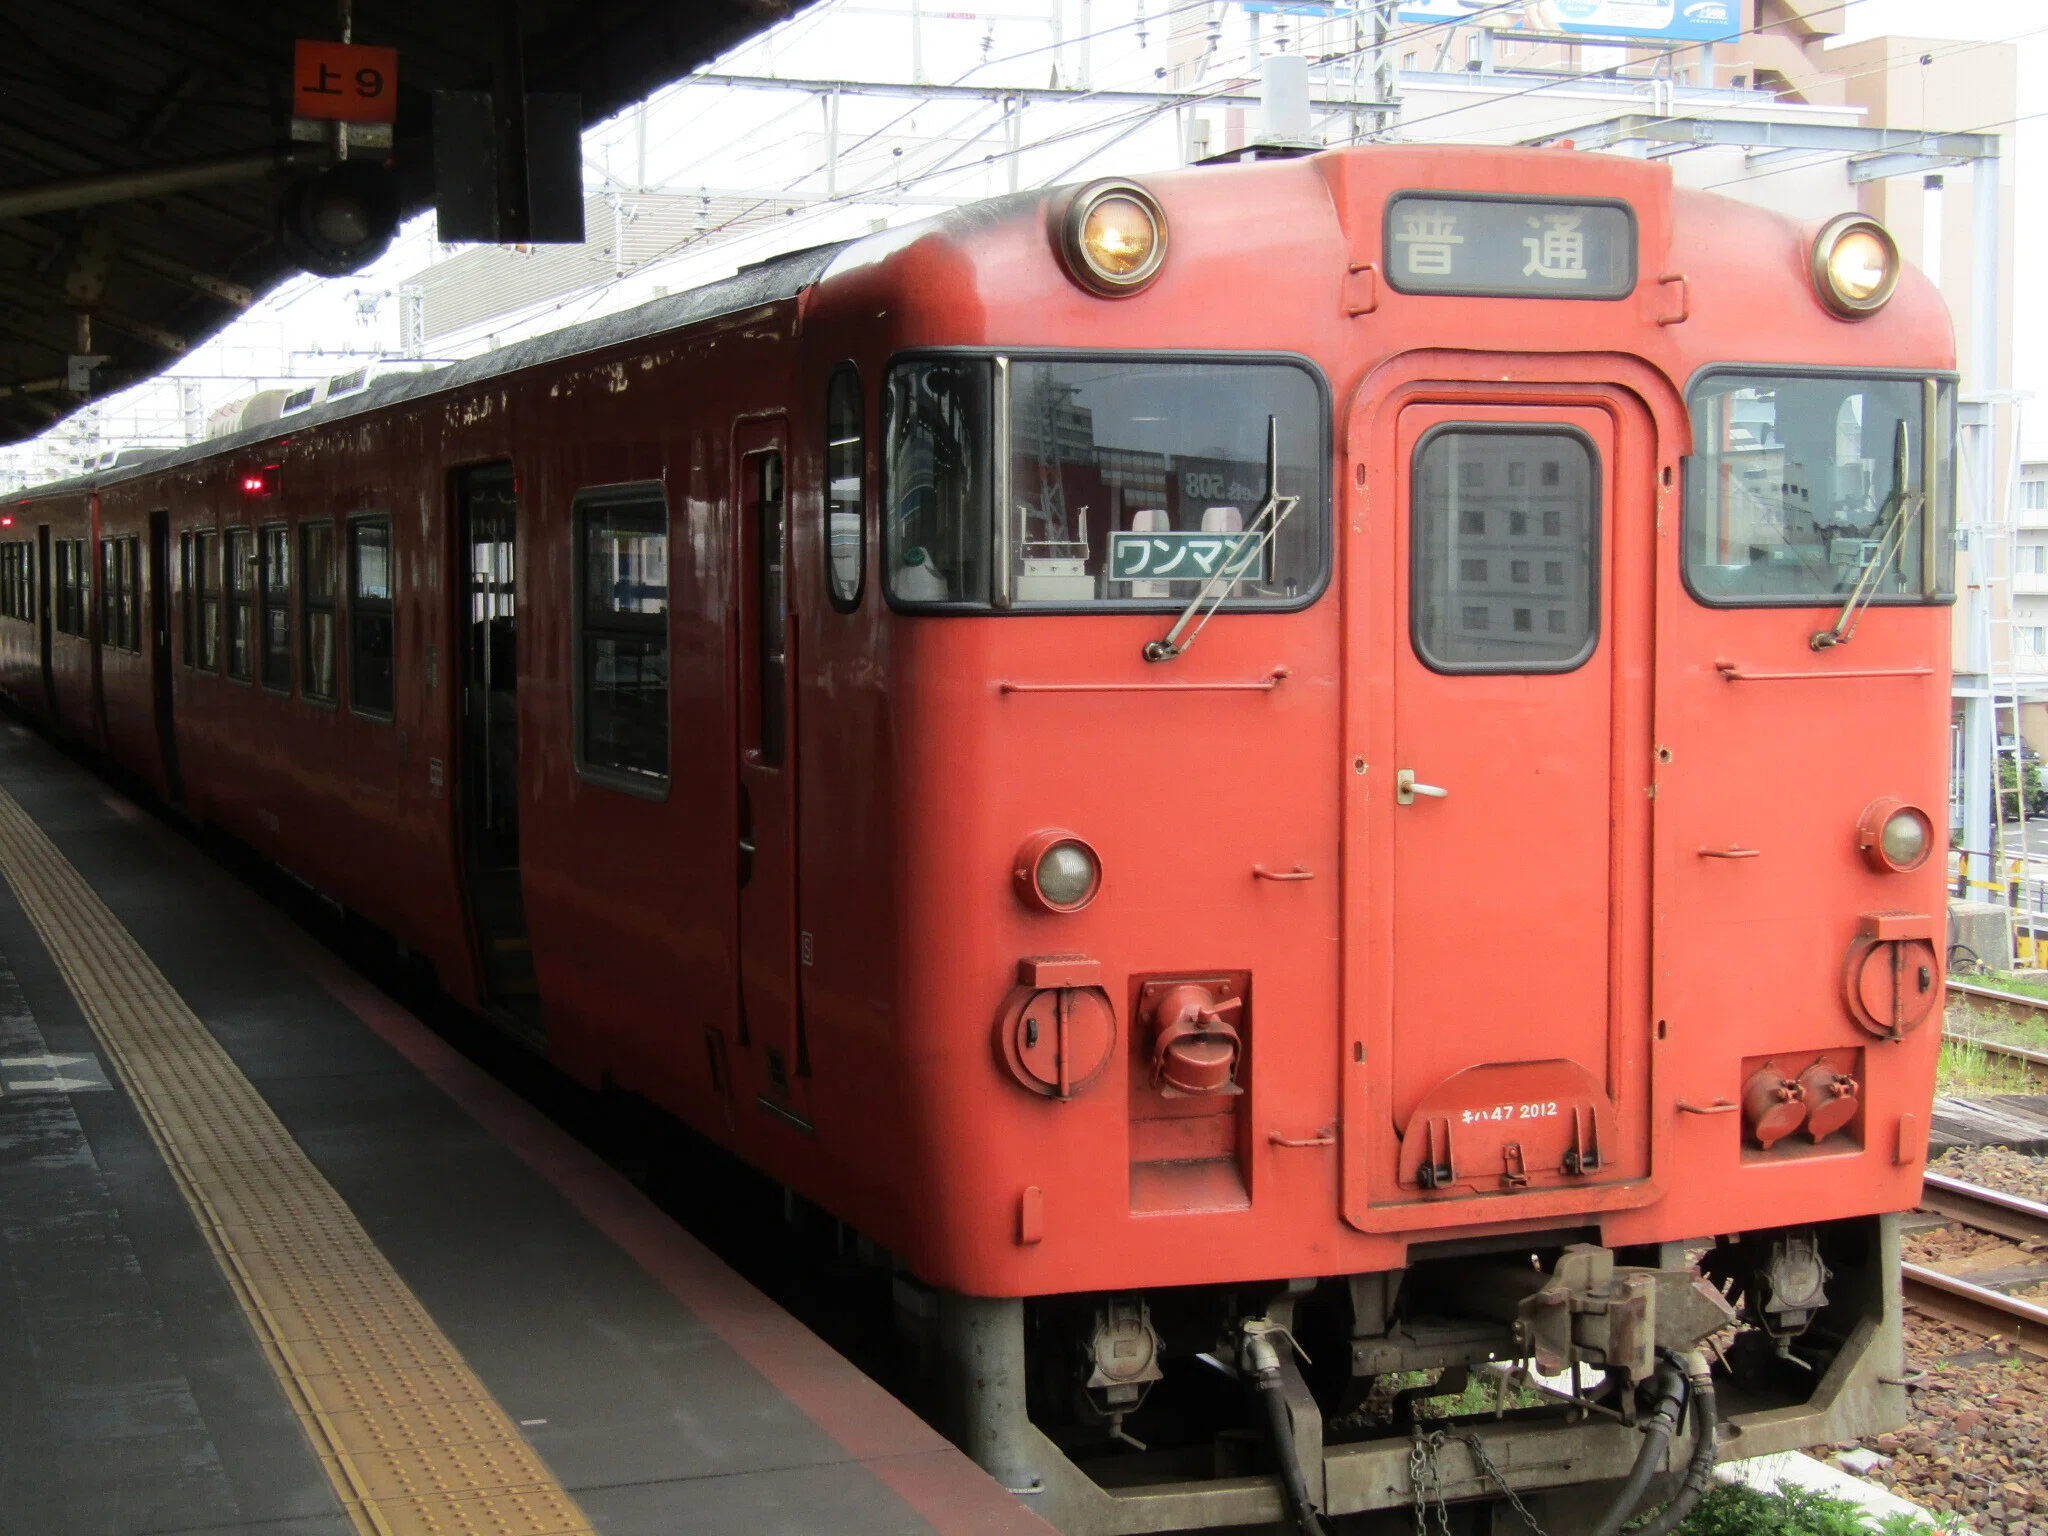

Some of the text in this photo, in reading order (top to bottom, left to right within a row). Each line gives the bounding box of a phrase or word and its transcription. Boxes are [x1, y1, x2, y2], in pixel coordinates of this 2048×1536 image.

[1117, 539, 1256, 575] ワンマン
[1462, 1102, 1557, 1124] キハ47 2012
